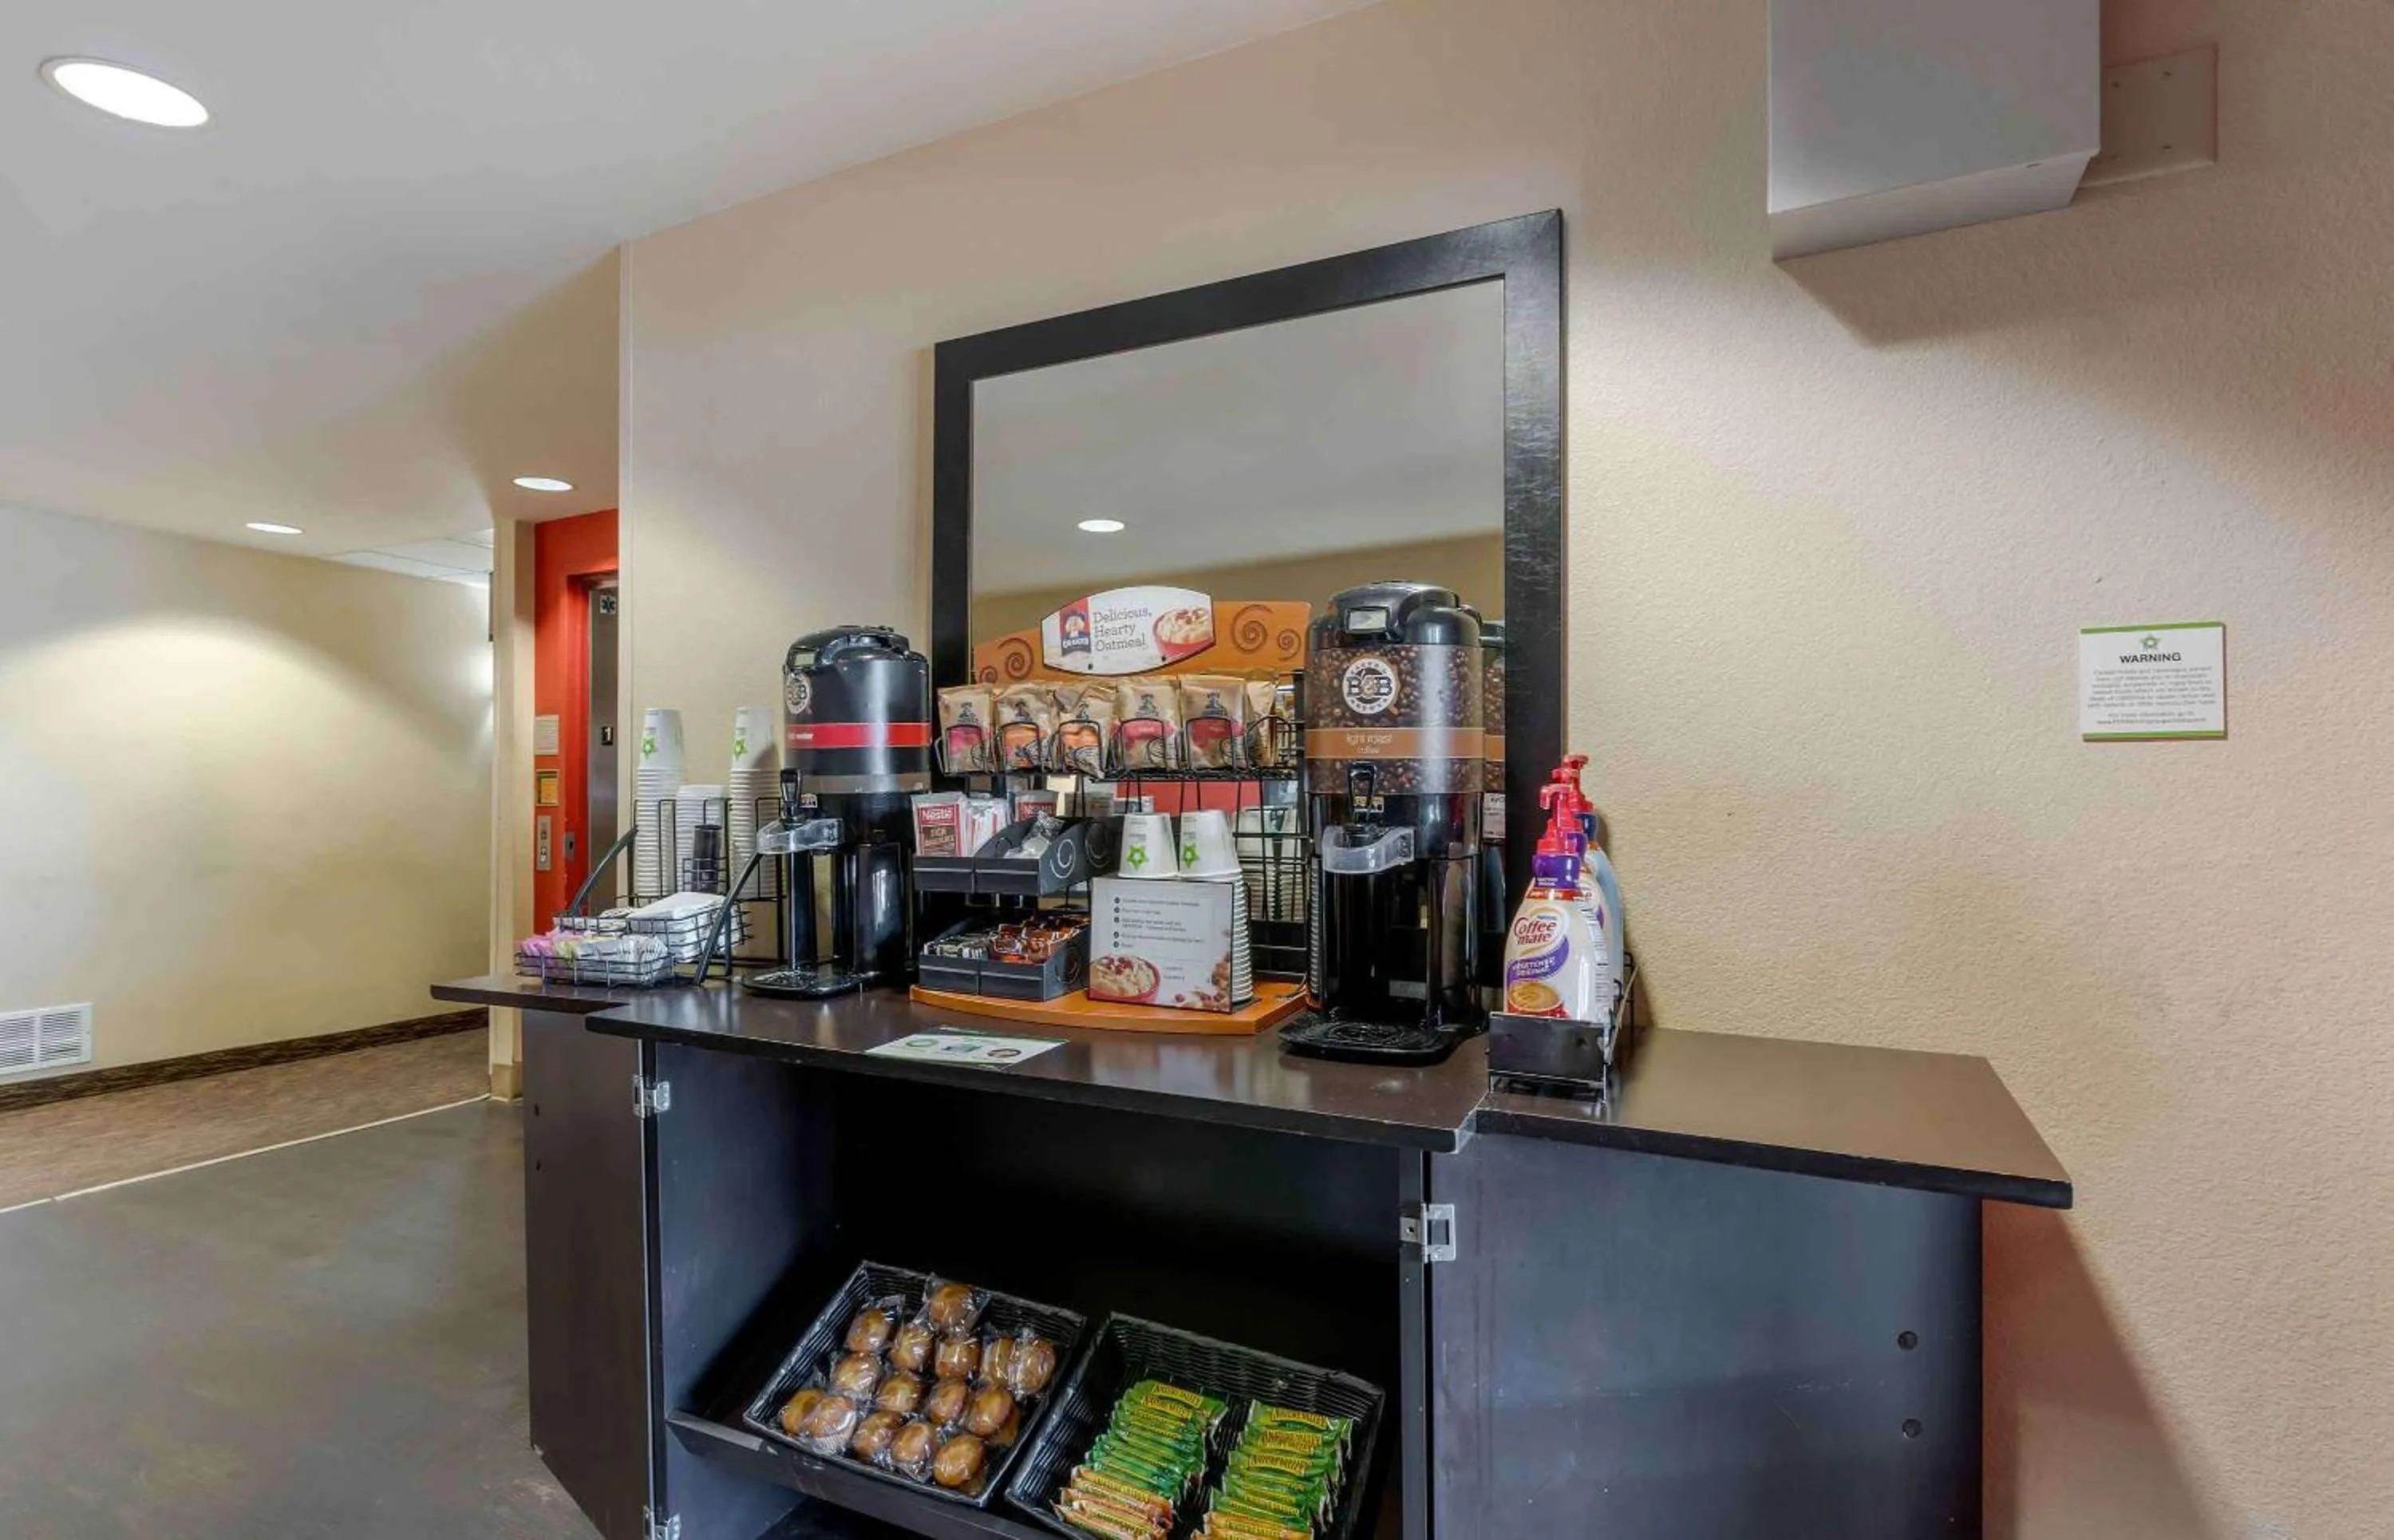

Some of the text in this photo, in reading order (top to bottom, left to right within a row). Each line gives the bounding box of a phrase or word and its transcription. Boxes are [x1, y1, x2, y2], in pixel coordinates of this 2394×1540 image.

[1092, 606, 1152, 622] Delicious,
[1095, 624, 1136, 638] Hearty
[1096, 633, 1146, 652] Oatmeal
[2119, 652, 2182, 663] WARNING
[605, 727, 610, 741] 1
[1514, 917, 1557, 937] Coffee
[1517, 933, 1552, 946] mate
